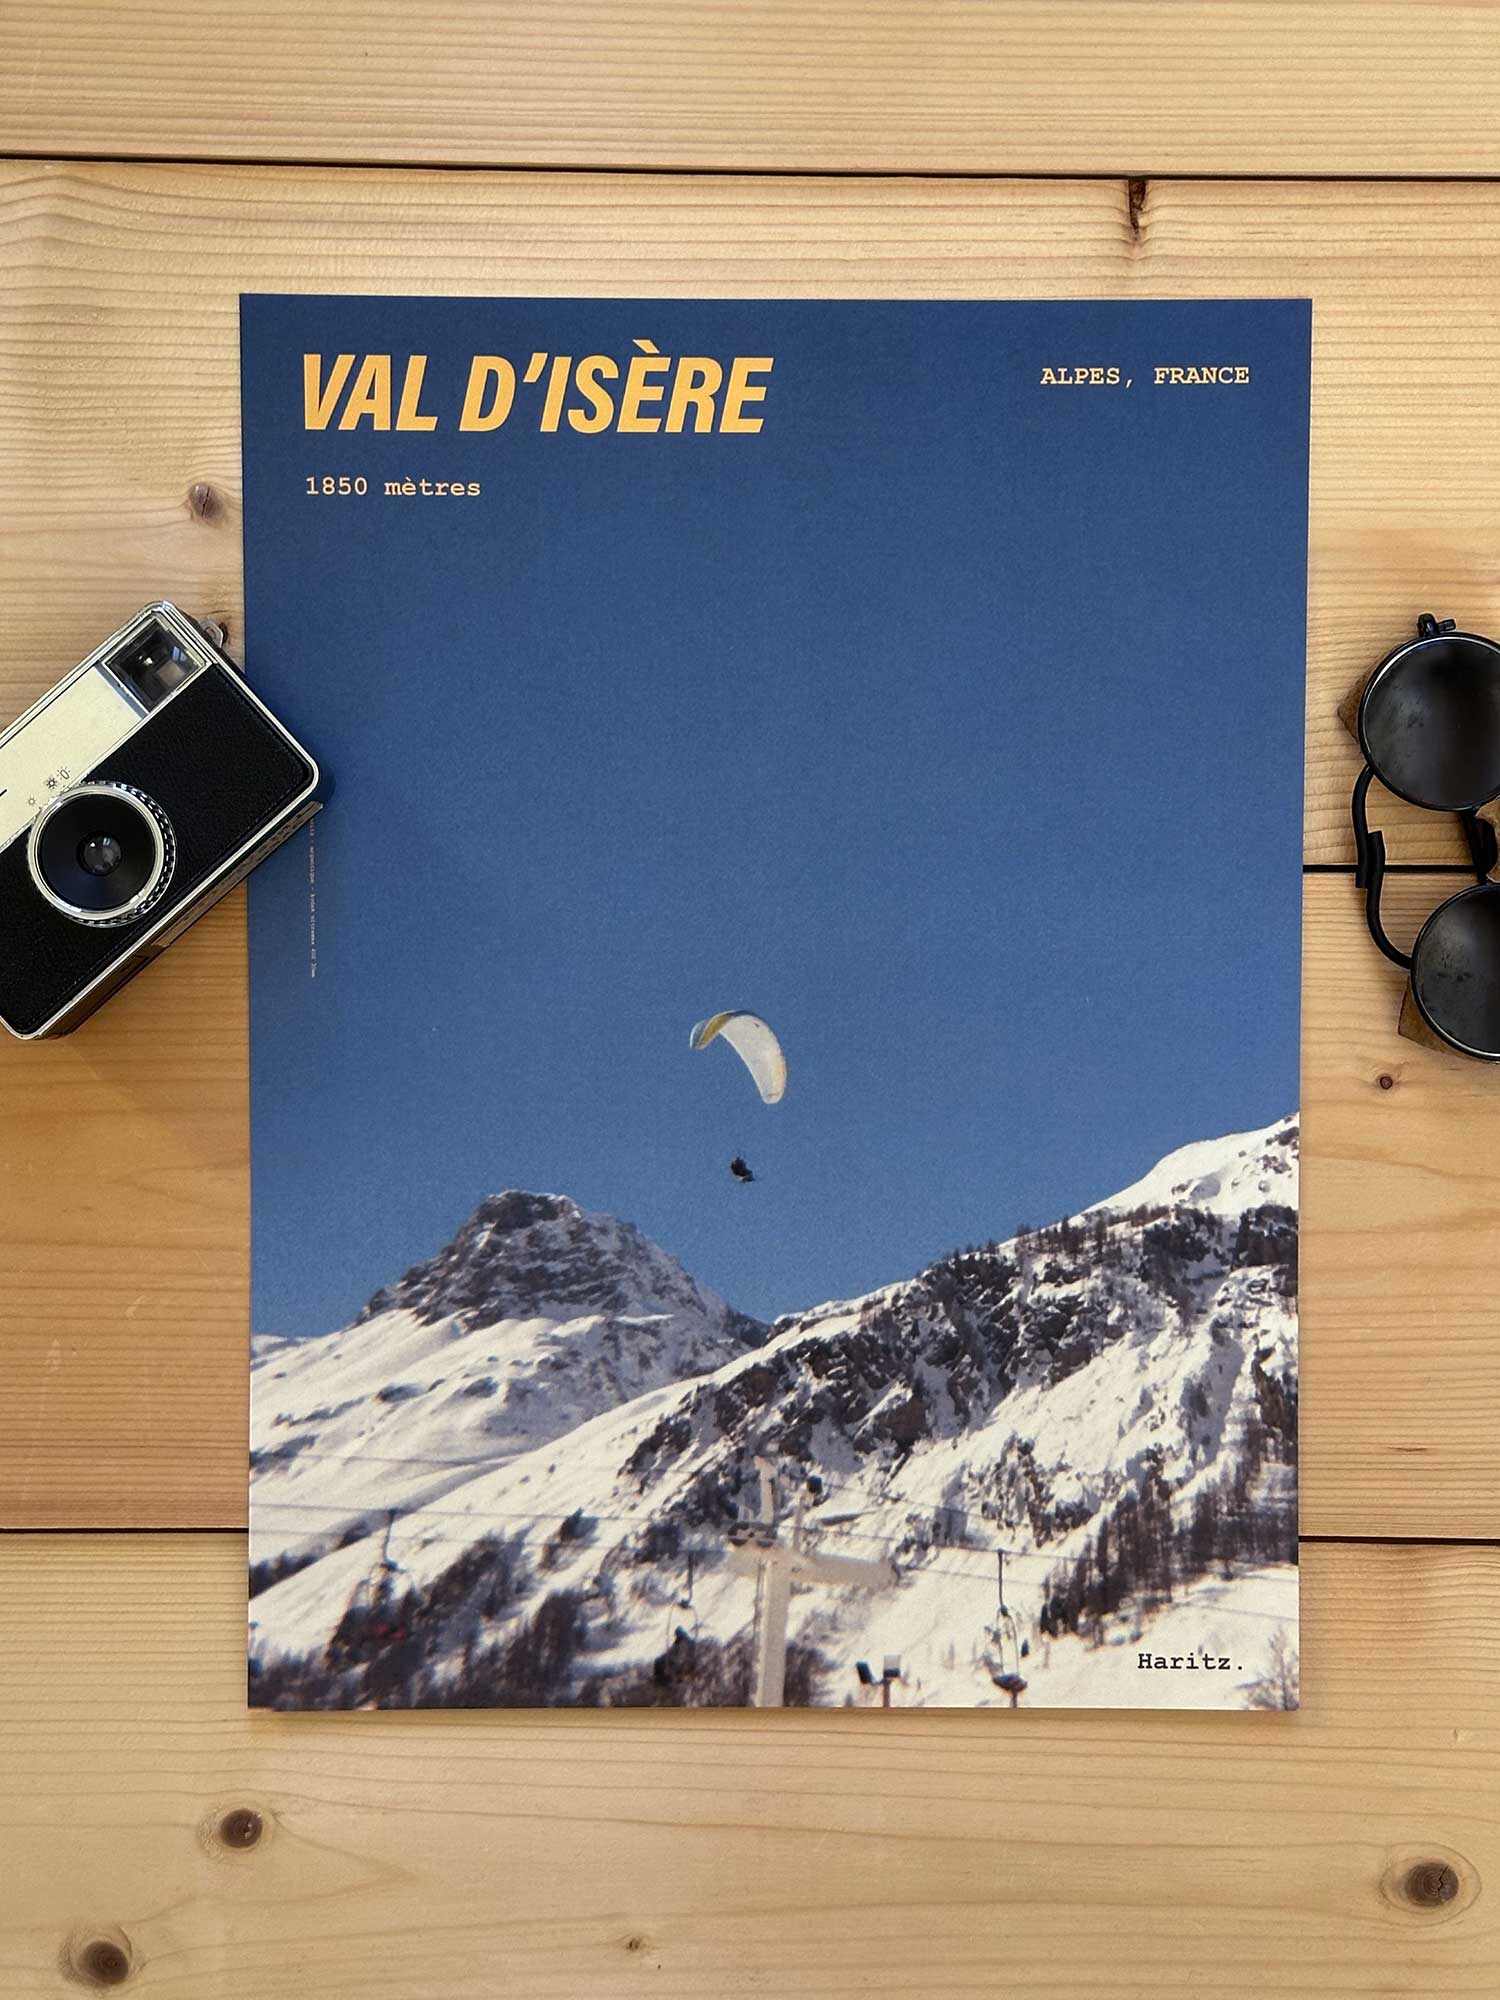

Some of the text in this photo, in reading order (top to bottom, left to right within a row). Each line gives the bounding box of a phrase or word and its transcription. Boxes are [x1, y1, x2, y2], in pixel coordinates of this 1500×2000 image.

[1039, 366, 1250, 389] ALPES, FRANCE
[303, 353, 438, 431] VAL
[305, 476, 481, 497] 1850 mètres
[1137, 1652, 1244, 1671] Haritz.
